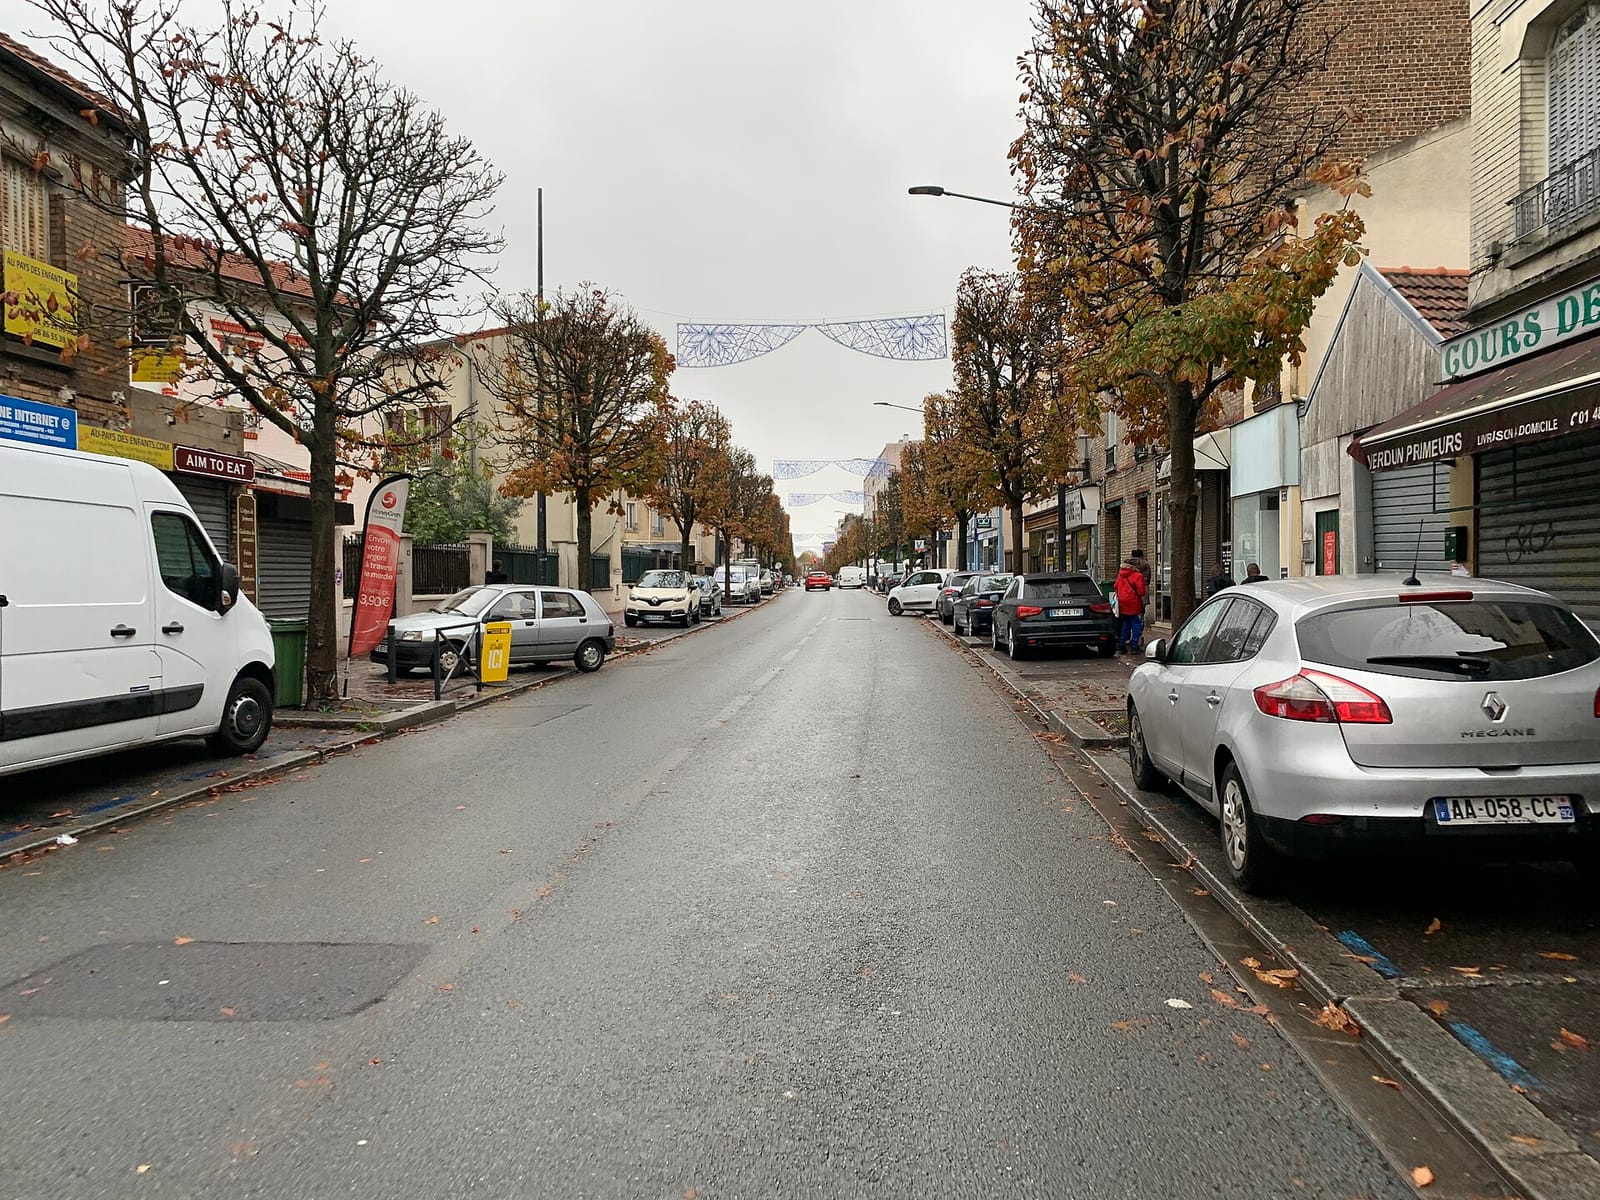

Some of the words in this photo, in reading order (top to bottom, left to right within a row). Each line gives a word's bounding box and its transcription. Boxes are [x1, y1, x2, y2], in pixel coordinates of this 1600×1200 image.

[7, 257, 15, 267] AU
[16, 260, 30, 272] PAYS
[31, 265, 41, 277] DES
[1444, 310, 1542, 376] COURS
[14, 408, 59, 428] INTERNET
[61, 417, 71, 430] @
[1518, 418, 1558, 436] DOMICILE
[1578, 409, 1589, 424] 01
[90, 428, 100, 437] AU
[101, 430, 117, 442] PAYS
[117, 434, 129, 444] DES
[130, 436, 170, 451] ENFANTS.COM
[1367, 446, 1404, 470] VERDUN
[1406, 432, 1462, 462] PRIMEURS
[186, 454, 207, 469] AIM
[209, 458, 224, 472] TO
[226, 461, 247, 476] EAT
[367, 545, 386, 553] votre
[488, 649, 503, 669] ICI
[1461, 728, 1536, 738] MEGANE
[1452, 797, 1557, 820] AA-058-CC
[1561, 808, 1573, 818] 92
